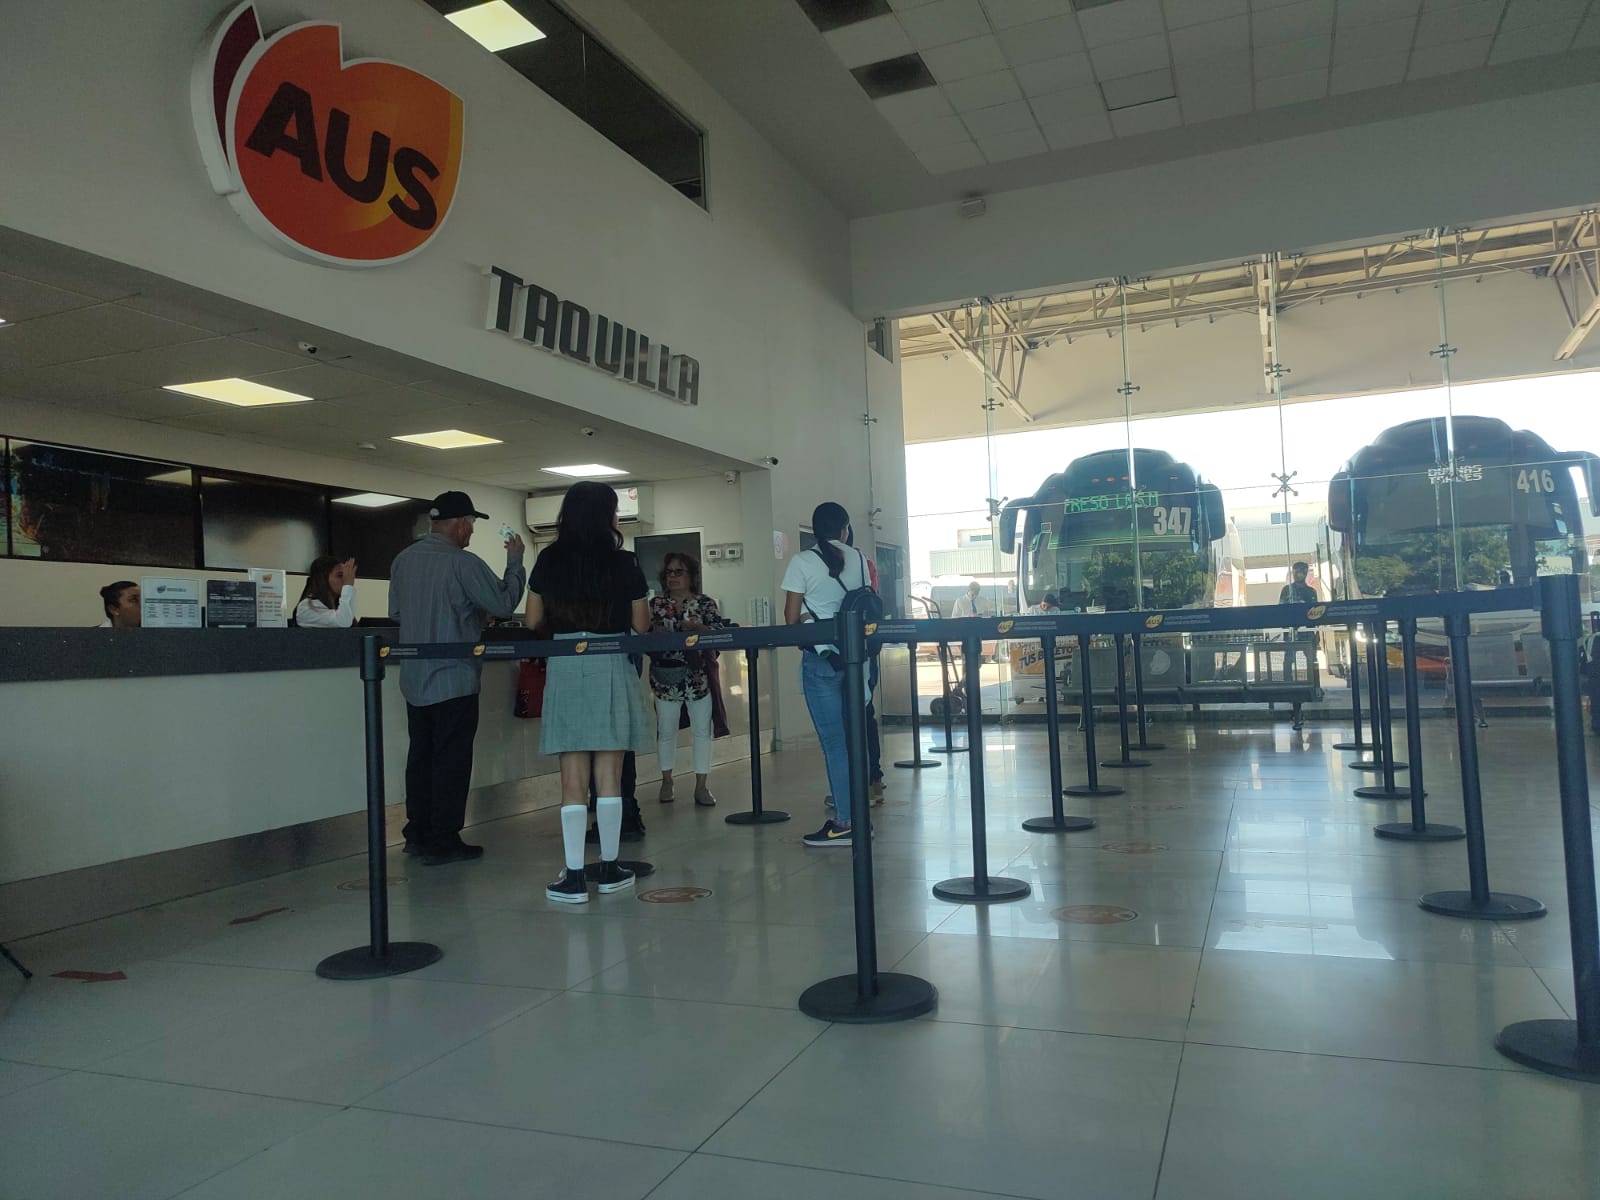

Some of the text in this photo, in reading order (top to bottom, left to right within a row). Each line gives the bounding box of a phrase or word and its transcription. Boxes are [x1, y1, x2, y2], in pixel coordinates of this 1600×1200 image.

[245, 81, 440, 231] AUS
[491, 265, 699, 406] TAQUILLA
[1153, 506, 1191, 535] 347
[1517, 469, 1555, 493] 416
